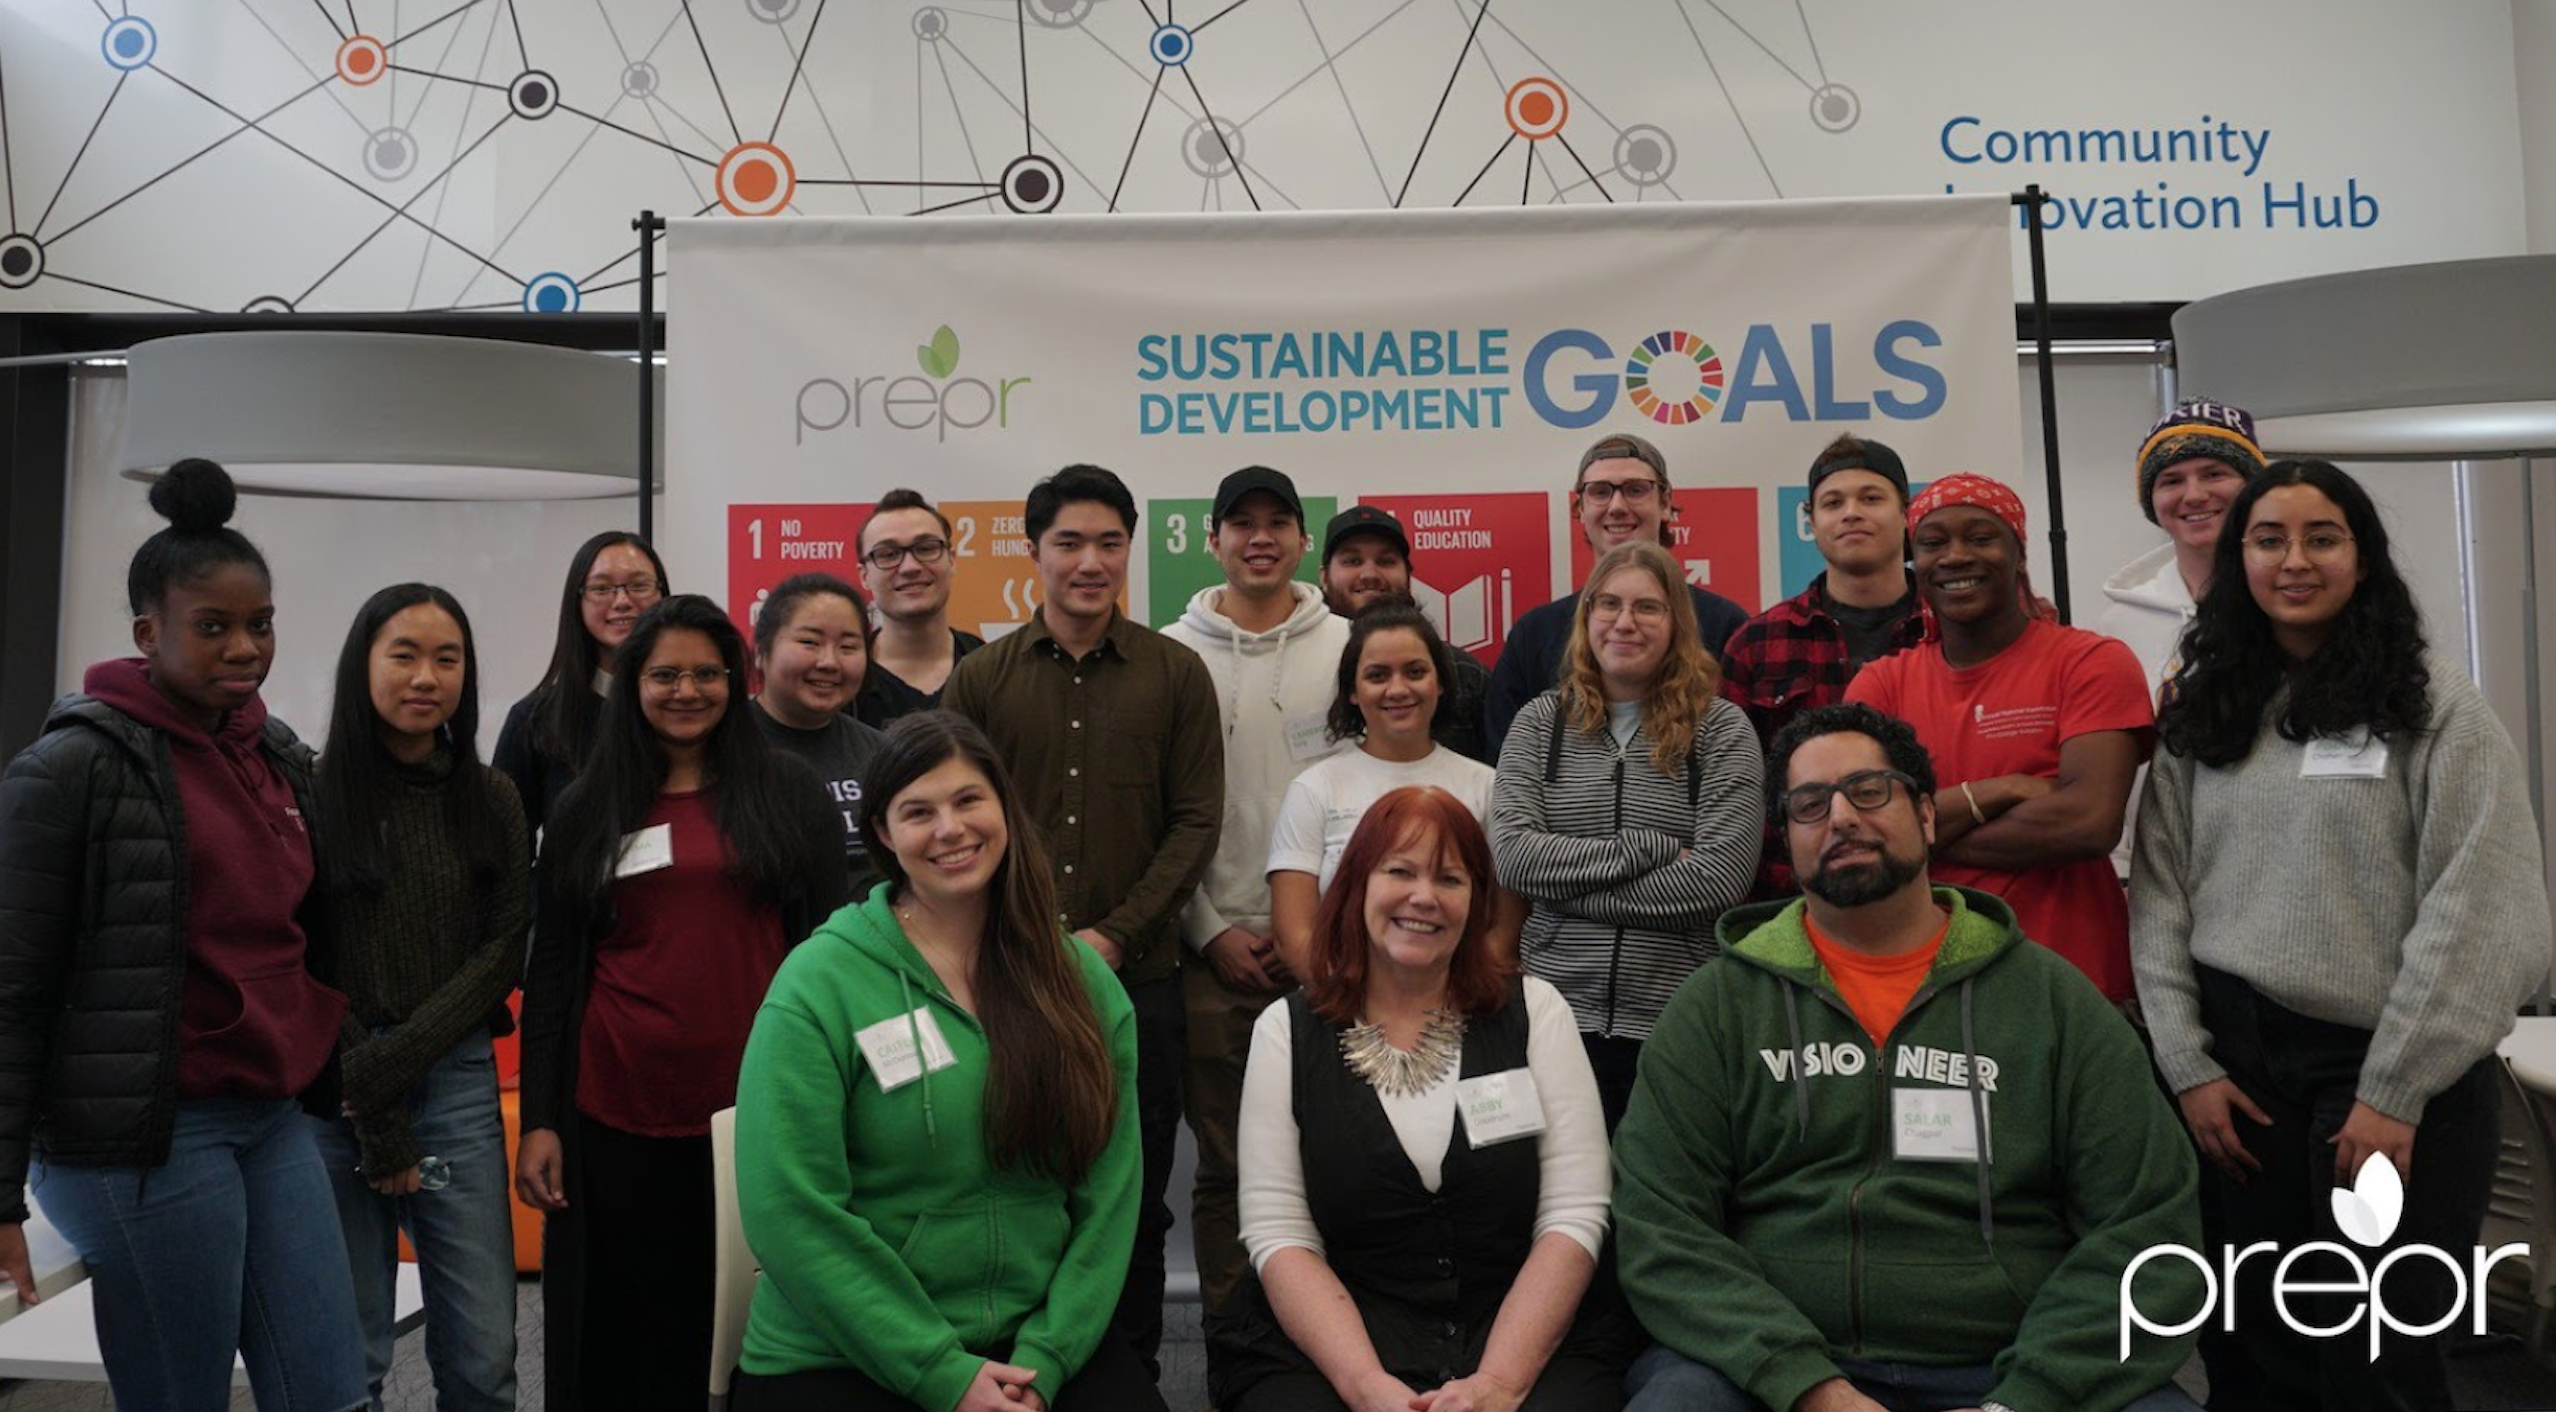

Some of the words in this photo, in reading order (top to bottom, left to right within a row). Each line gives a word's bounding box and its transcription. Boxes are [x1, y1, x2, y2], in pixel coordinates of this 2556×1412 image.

[1940, 115, 2270, 177] Community
[2263, 178, 2380, 228] Hub
[1137, 329, 1509, 381] SUSTAINABLE
[1523, 320, 1947, 430] GOALS
[795, 375, 1032, 447] prepr
[1138, 386, 1510, 435] DEVELOPMENT
[748, 518, 763, 559] 1
[781, 519, 801, 537] NO
[956, 516, 976, 558] 2
[1165, 513, 1188, 554] 3
[1413, 509, 1472, 528] QUALITY
[781, 540, 844, 559] POVERTY
[991, 539, 1030, 557] HUNG
[1413, 530, 1492, 550] EDUCATION
[1903, 1112, 1952, 1128] SALAR
